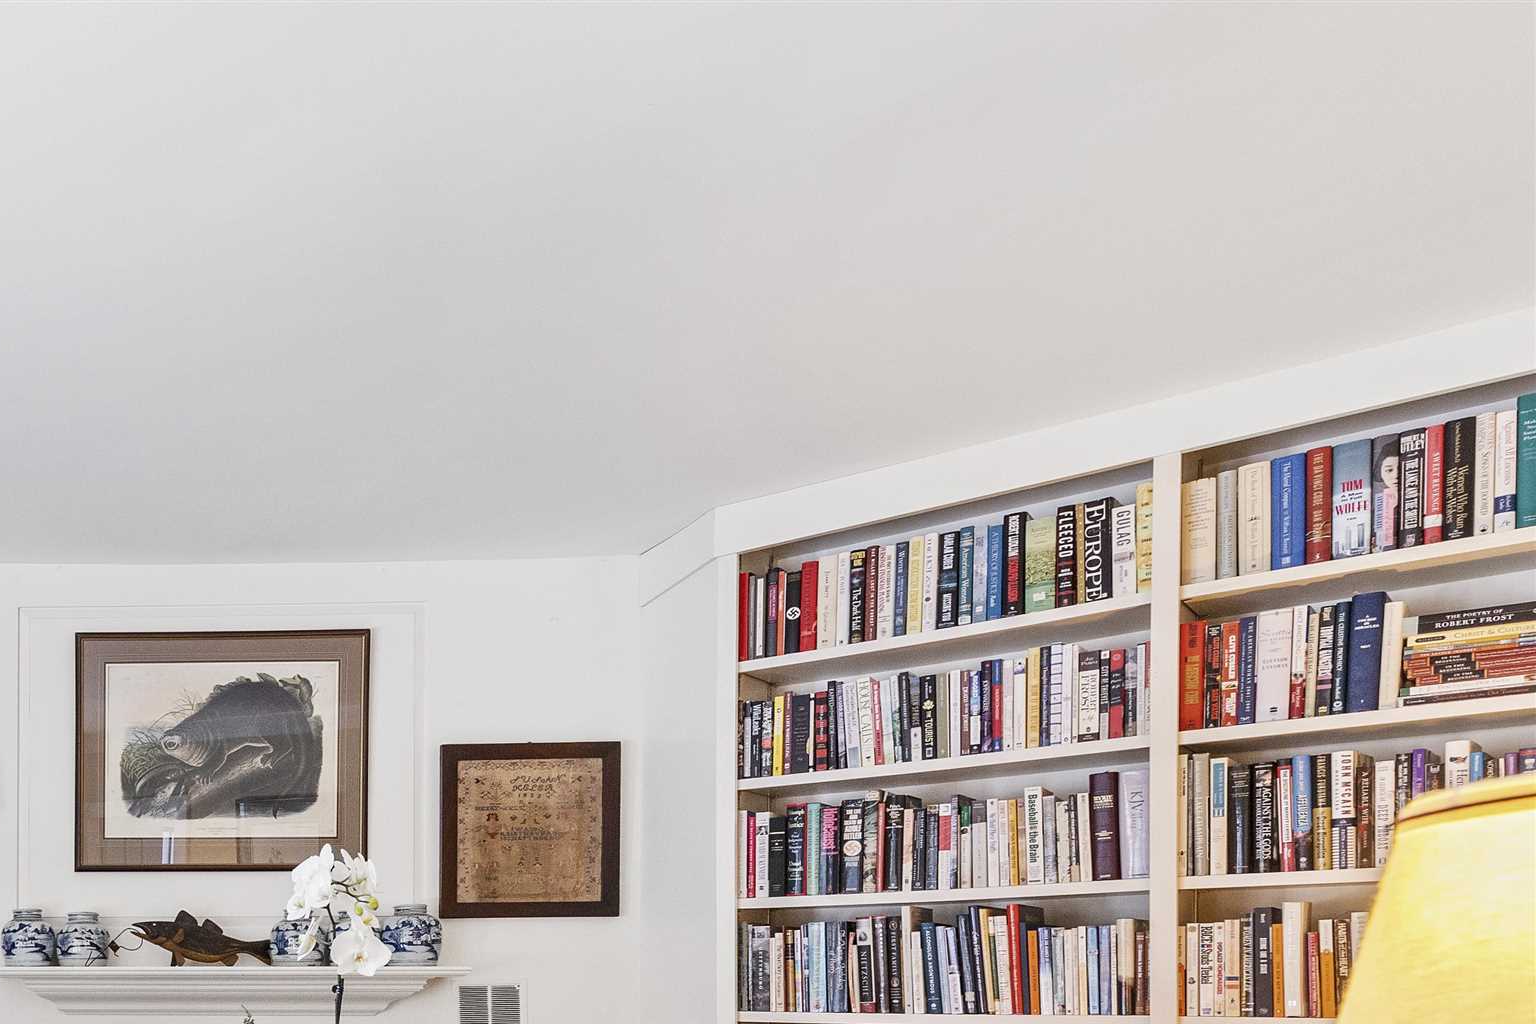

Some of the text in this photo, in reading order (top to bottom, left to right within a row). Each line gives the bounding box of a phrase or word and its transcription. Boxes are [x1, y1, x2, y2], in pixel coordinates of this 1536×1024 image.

[1313, 453, 1323, 464] THE
[1401, 440, 1425, 453] UTLEY
[1313, 465, 1322, 473] DA
[1313, 473, 1323, 491] VINCI
[1431, 452, 1440, 512] SWEET REVENGE
[1313, 491, 1323, 506] CODE
[1404, 458, 1418, 529] THE LANCE AND THE SHIELD
[1446, 467, 1457, 523] With the Wolves
[1457, 465, 1469, 529] Women Who Run
[1008, 515, 1019, 557] ROBERT LUDLUM
[1058, 511, 1074, 558] FLEECED
[1116, 510, 1131, 546] GULAG
[943, 533, 955, 570] HARLAN COBEN
[1084, 500, 1107, 601] EUROPE
[961, 548, 970, 604] American Women
[852, 588, 862, 631] The Dark Half
[1435, 614, 1514, 629] ROBERT FROST
[1463, 610, 1491, 618] POETRY
[1228, 635, 1237, 680] CLIVE CUSSLER
[1335, 612, 1345, 671] THE CELESTINE PROPHECY
[1081, 675, 1089, 712] FROST
[752, 704, 760, 736] WikiLeaks
[924, 718, 933, 746] TOURIST
[1316, 755, 1327, 805] FRANCIS FUKUYAMA
[1341, 754, 1352, 815] JOHN McCAIN
[1129, 791, 1144, 813] KJV
[1263, 787, 1271, 859] AGAINST THE GODS
[1296, 794, 1307, 827] AFFLUENZA
[823, 808, 837, 850] Holocaust
[1028, 794, 1038, 863] Baseball the Brain
[1377, 804, 1389, 850] DEEP THROAT
[1201, 926, 1213, 984] RACE Studs Terkel
[1338, 923, 1348, 976] HABITS HEART
[927, 962, 935, 994] ANONYMOUS
